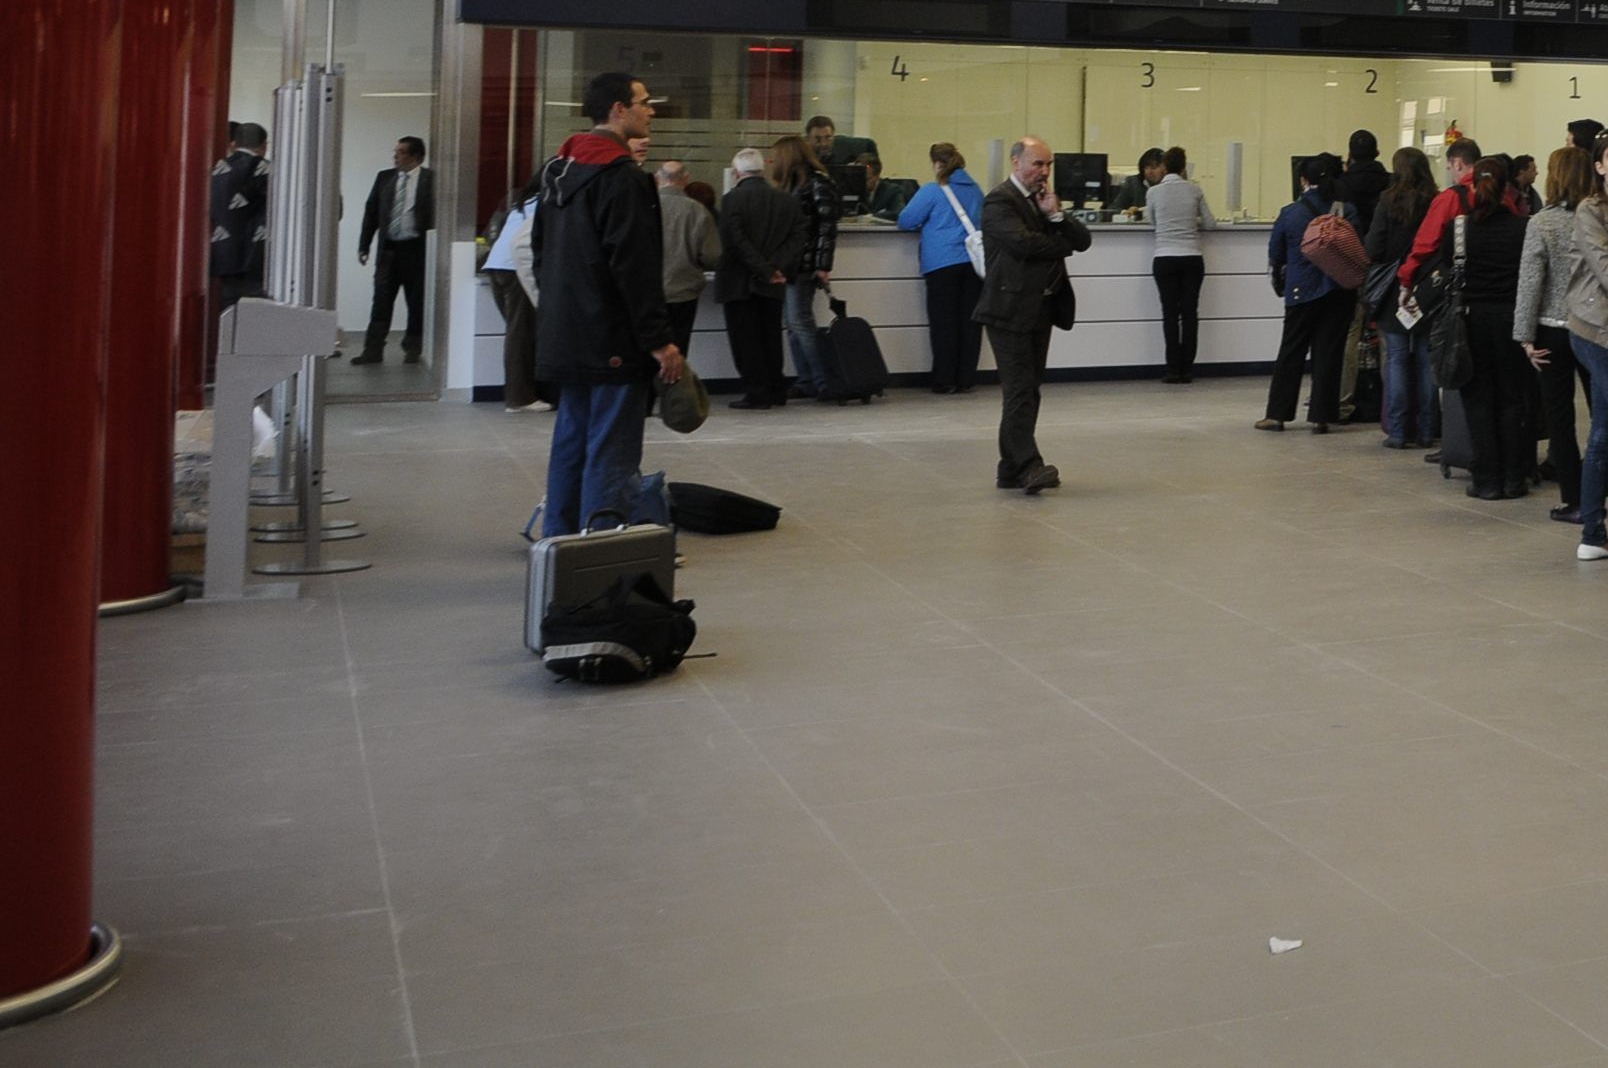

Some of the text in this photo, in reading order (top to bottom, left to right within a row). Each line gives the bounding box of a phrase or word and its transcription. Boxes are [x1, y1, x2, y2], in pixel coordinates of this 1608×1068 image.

[890, 55, 910, 82] 4
[1141, 62, 1155, 88] 3
[1365, 69, 1379, 94] 2
[1569, 76, 1582, 99] 1
